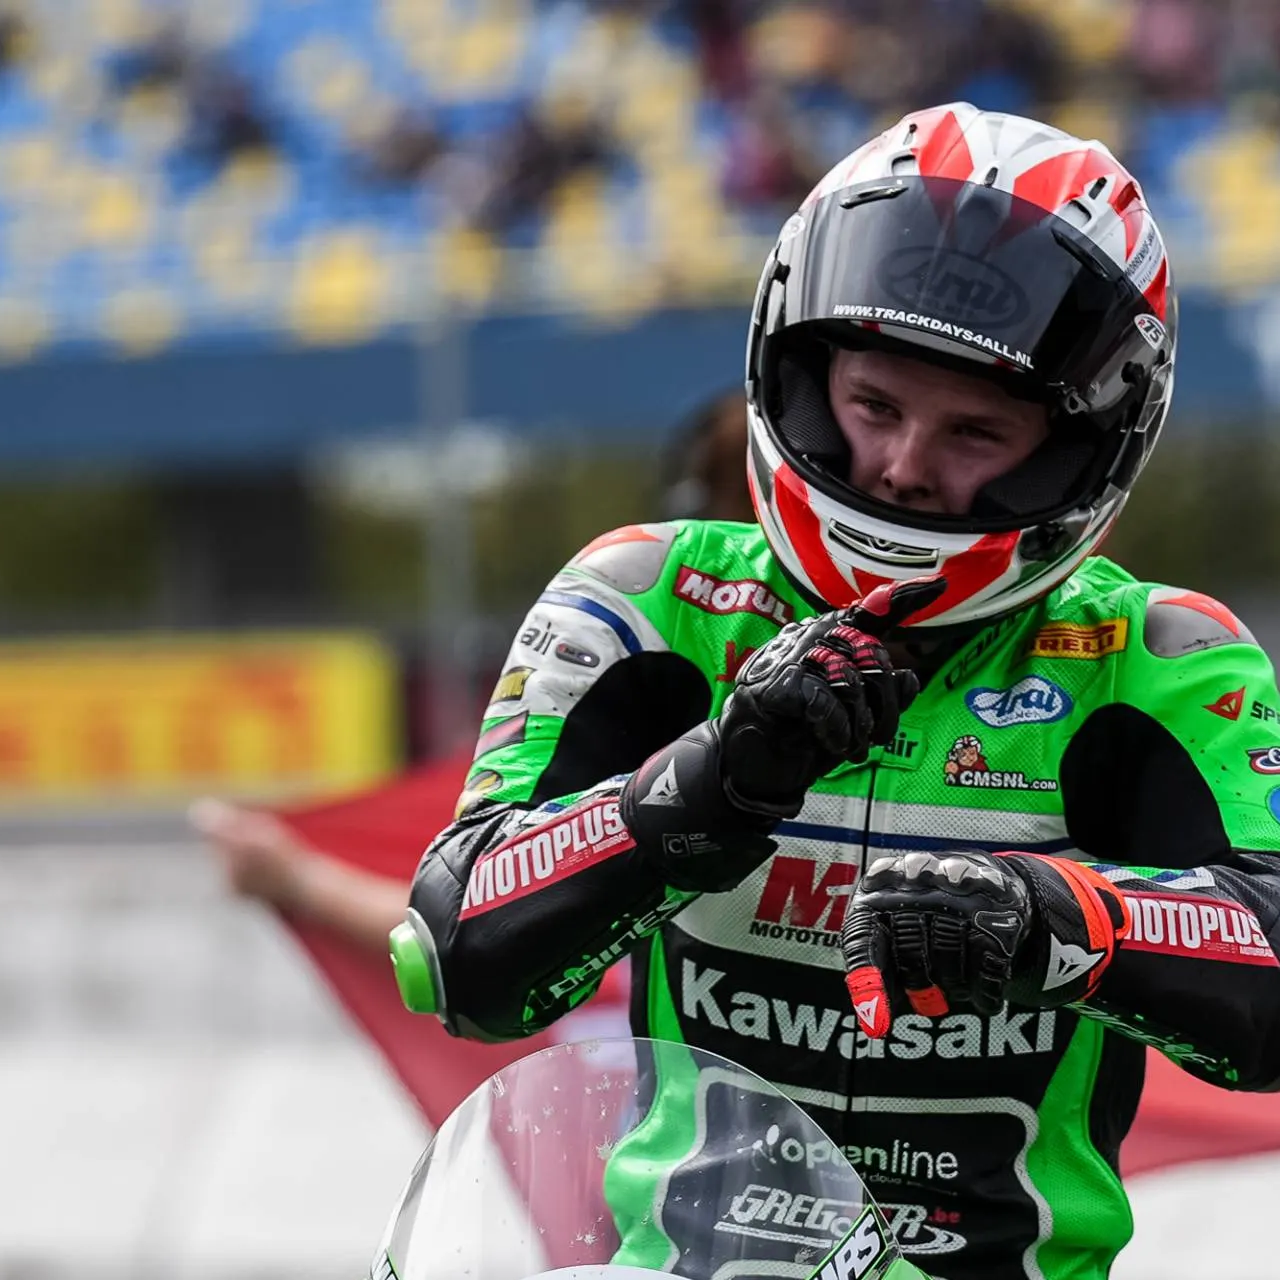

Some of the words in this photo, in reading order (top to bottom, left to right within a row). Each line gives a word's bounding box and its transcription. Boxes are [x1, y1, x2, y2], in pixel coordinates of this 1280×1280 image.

[832, 304, 1034, 370] WWW.TRACKDAYS4ALL.NL
[680, 572, 789, 625] MOTUL
[460, 801, 628, 912] MOTOPLUS
